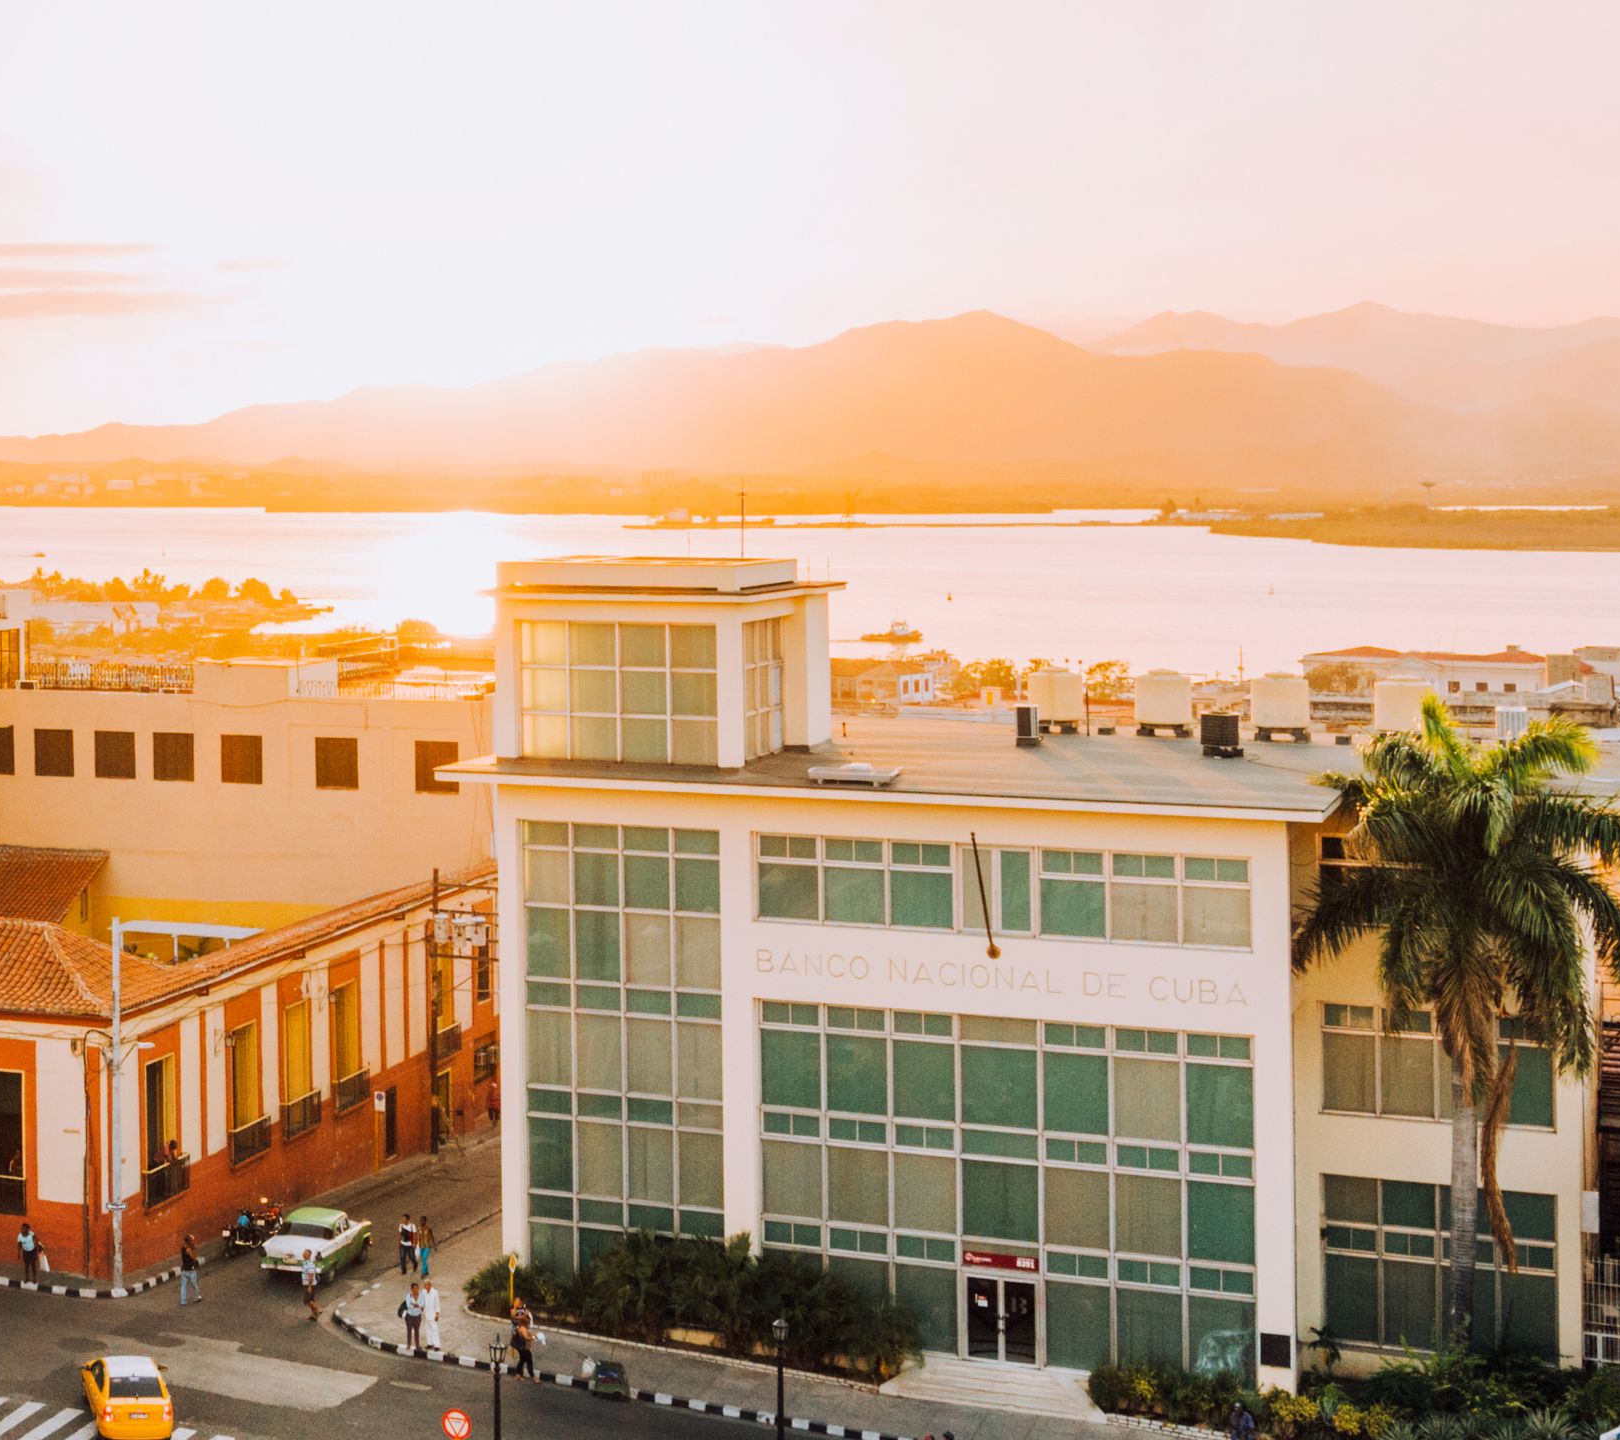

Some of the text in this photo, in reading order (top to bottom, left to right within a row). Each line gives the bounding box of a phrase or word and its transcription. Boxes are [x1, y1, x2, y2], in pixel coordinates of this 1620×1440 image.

[756, 948, 1249, 1006] BANCO NACIONAL DE CUBA
